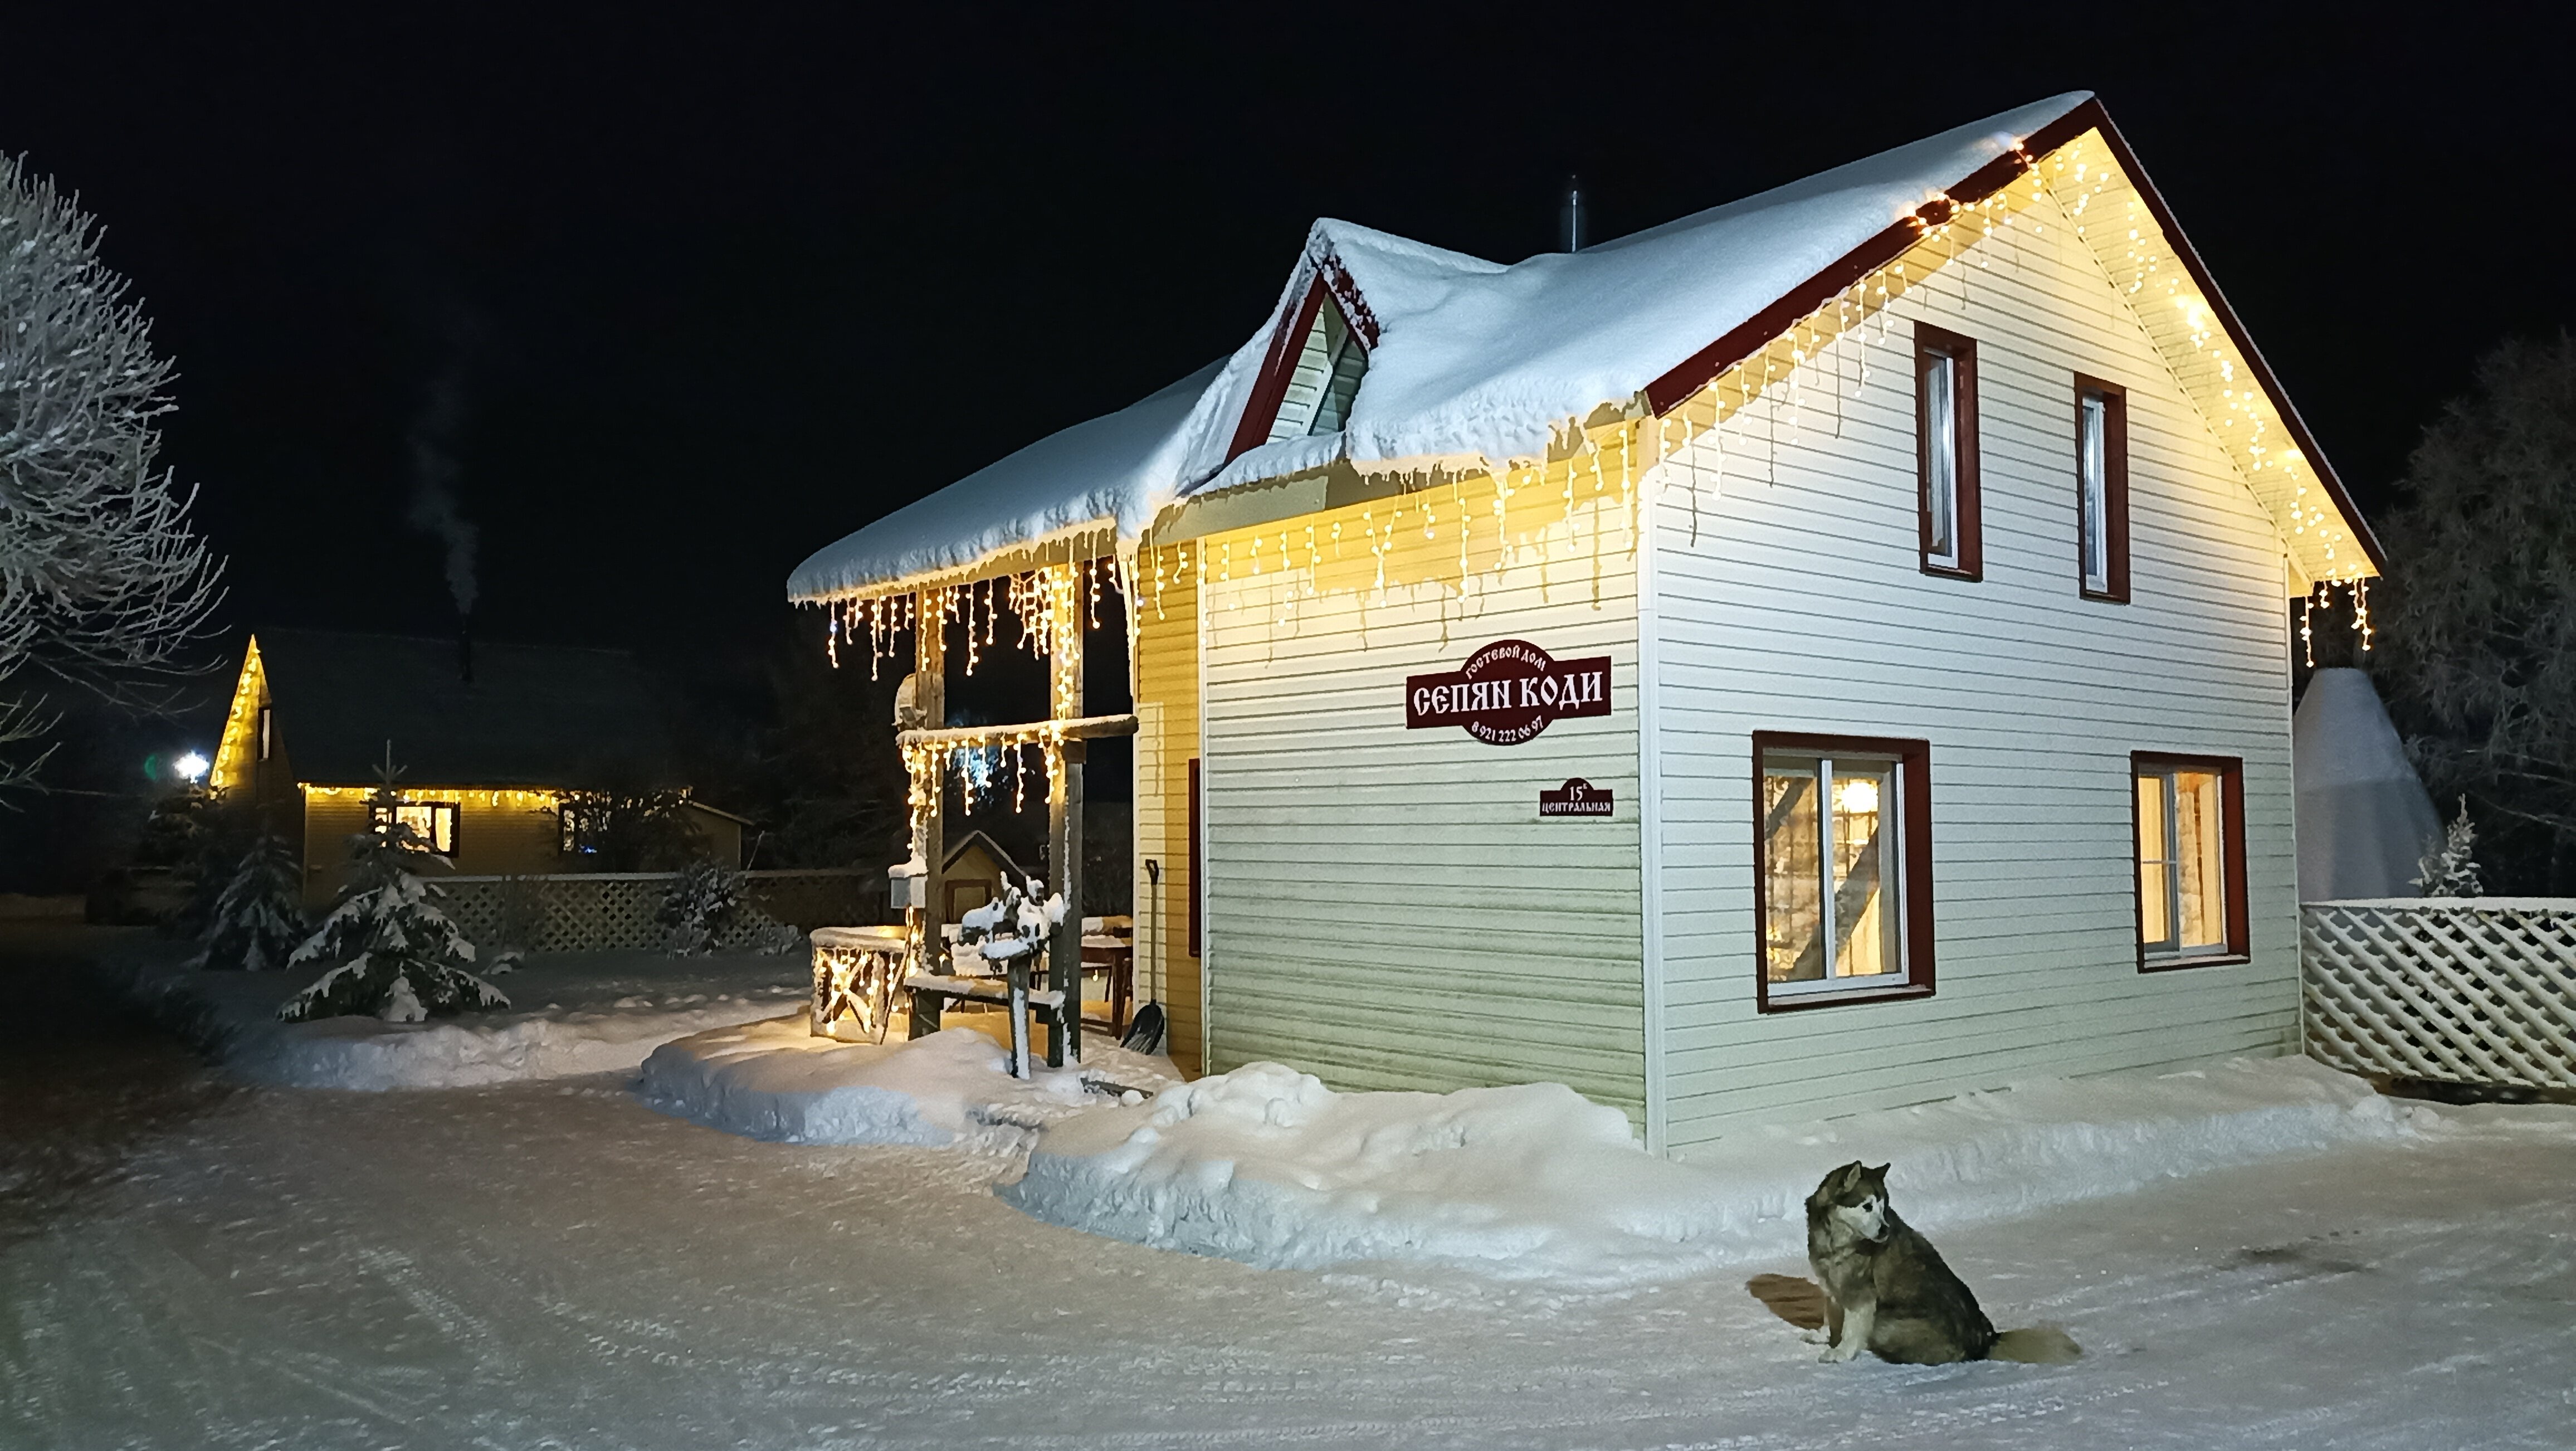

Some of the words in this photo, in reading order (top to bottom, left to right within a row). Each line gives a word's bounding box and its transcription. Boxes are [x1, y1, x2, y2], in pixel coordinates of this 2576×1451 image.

[1466, 645, 1520, 680] ГОСТЕВОЙ
[1520, 649, 1546, 671] ДОМ
[1519, 671, 1603, 710] КОДИ
[1471, 721, 1479, 733] 8
[1479, 726, 1496, 742] 921
[1498, 729, 1517, 743] 222
[1518, 724, 1531, 739] 06
[1531, 715, 1544, 732] 97
[1541, 802, 1611, 814] ЦЕНТРАЛЬНАЯ
